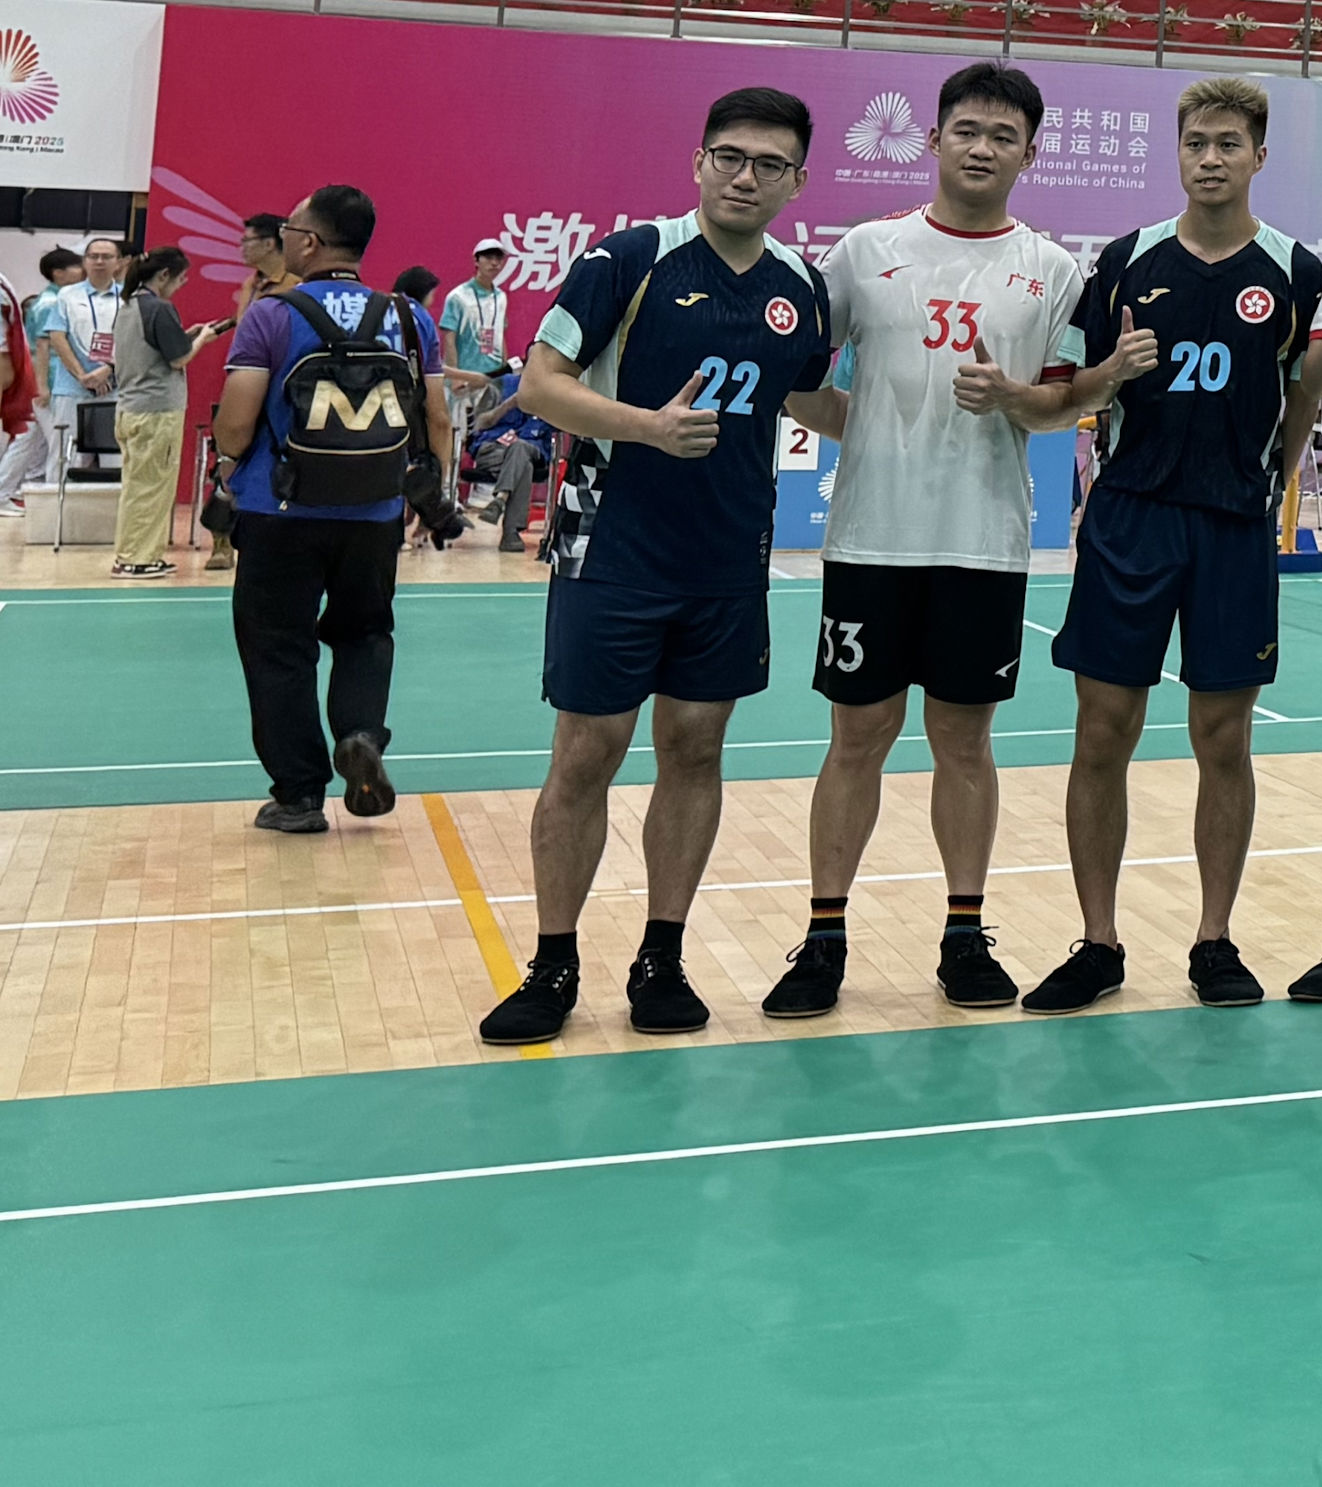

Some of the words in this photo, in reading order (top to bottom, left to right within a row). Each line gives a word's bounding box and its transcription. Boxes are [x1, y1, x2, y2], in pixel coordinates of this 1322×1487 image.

[1043, 106, 1150, 134] 民共和国
[1040, 132, 1149, 158] 届运动会
[1033, 173, 1089, 187] Republic
[1093, 177, 1107, 187] of
[1110, 177, 1145, 189] China
[1082, 161, 1127, 173] Games
[1132, 163, 1147, 174] of
[1006, 273, 1045, 297] 广东
[922, 299, 982, 352] 33
[1167, 341, 1231, 392] 20
[691, 356, 761, 415] 22
[306, 379, 409, 431] M
[789, 428, 809, 454] 2
